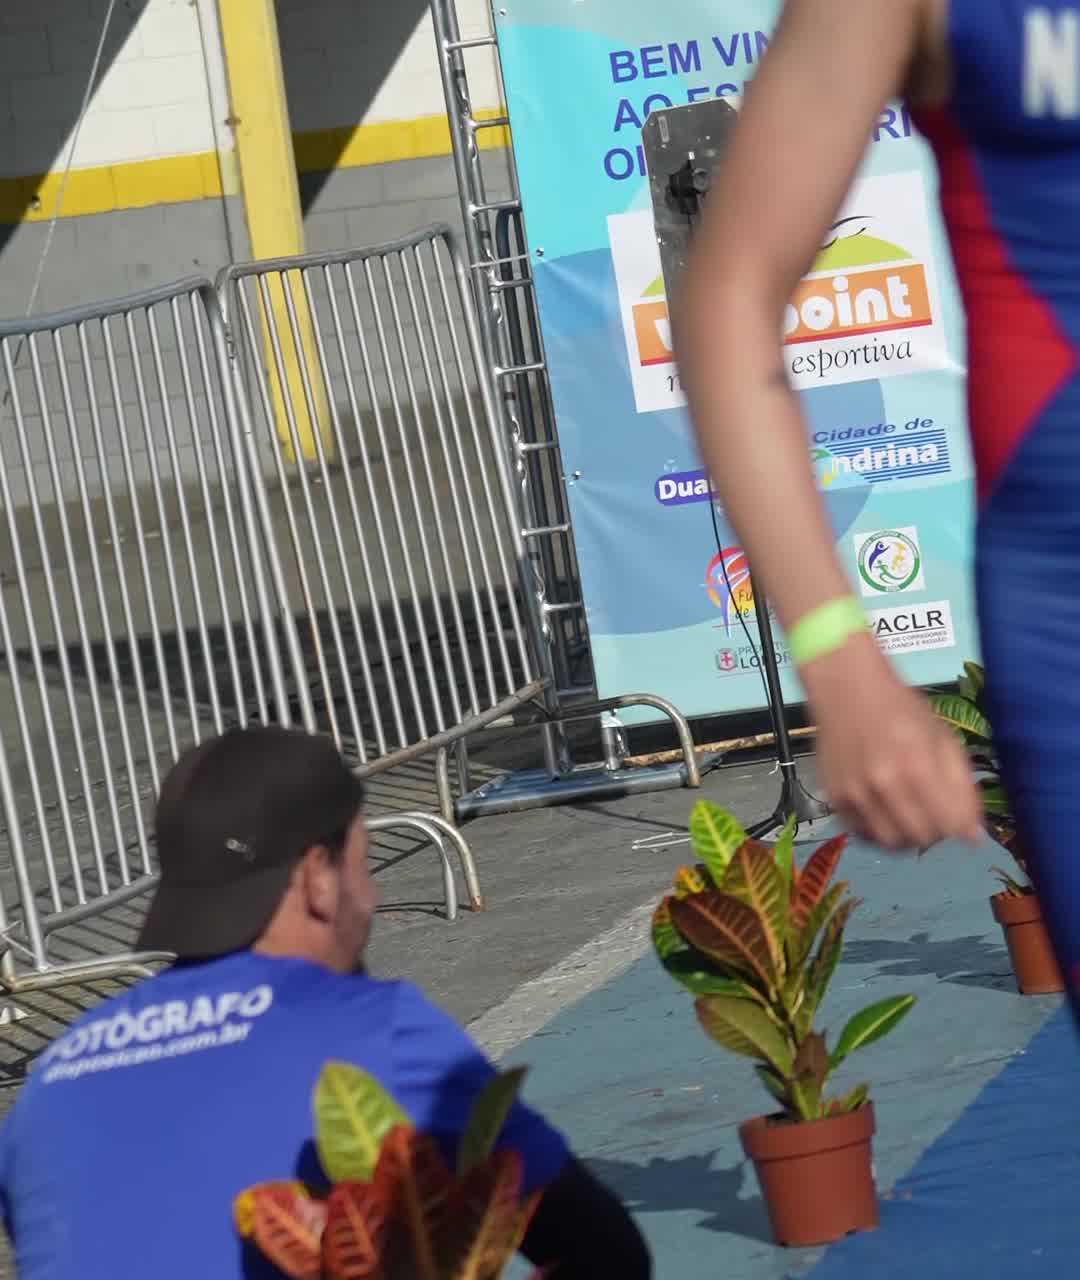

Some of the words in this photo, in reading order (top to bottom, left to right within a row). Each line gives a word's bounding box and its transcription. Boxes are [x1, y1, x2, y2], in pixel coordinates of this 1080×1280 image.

[609, 40, 702, 83] BEM
[791, 337, 913, 378] esportiva
[813, 422, 896, 445] Cidade
[904, 417, 934, 431] de
[876, 610, 945, 635] ACLR
